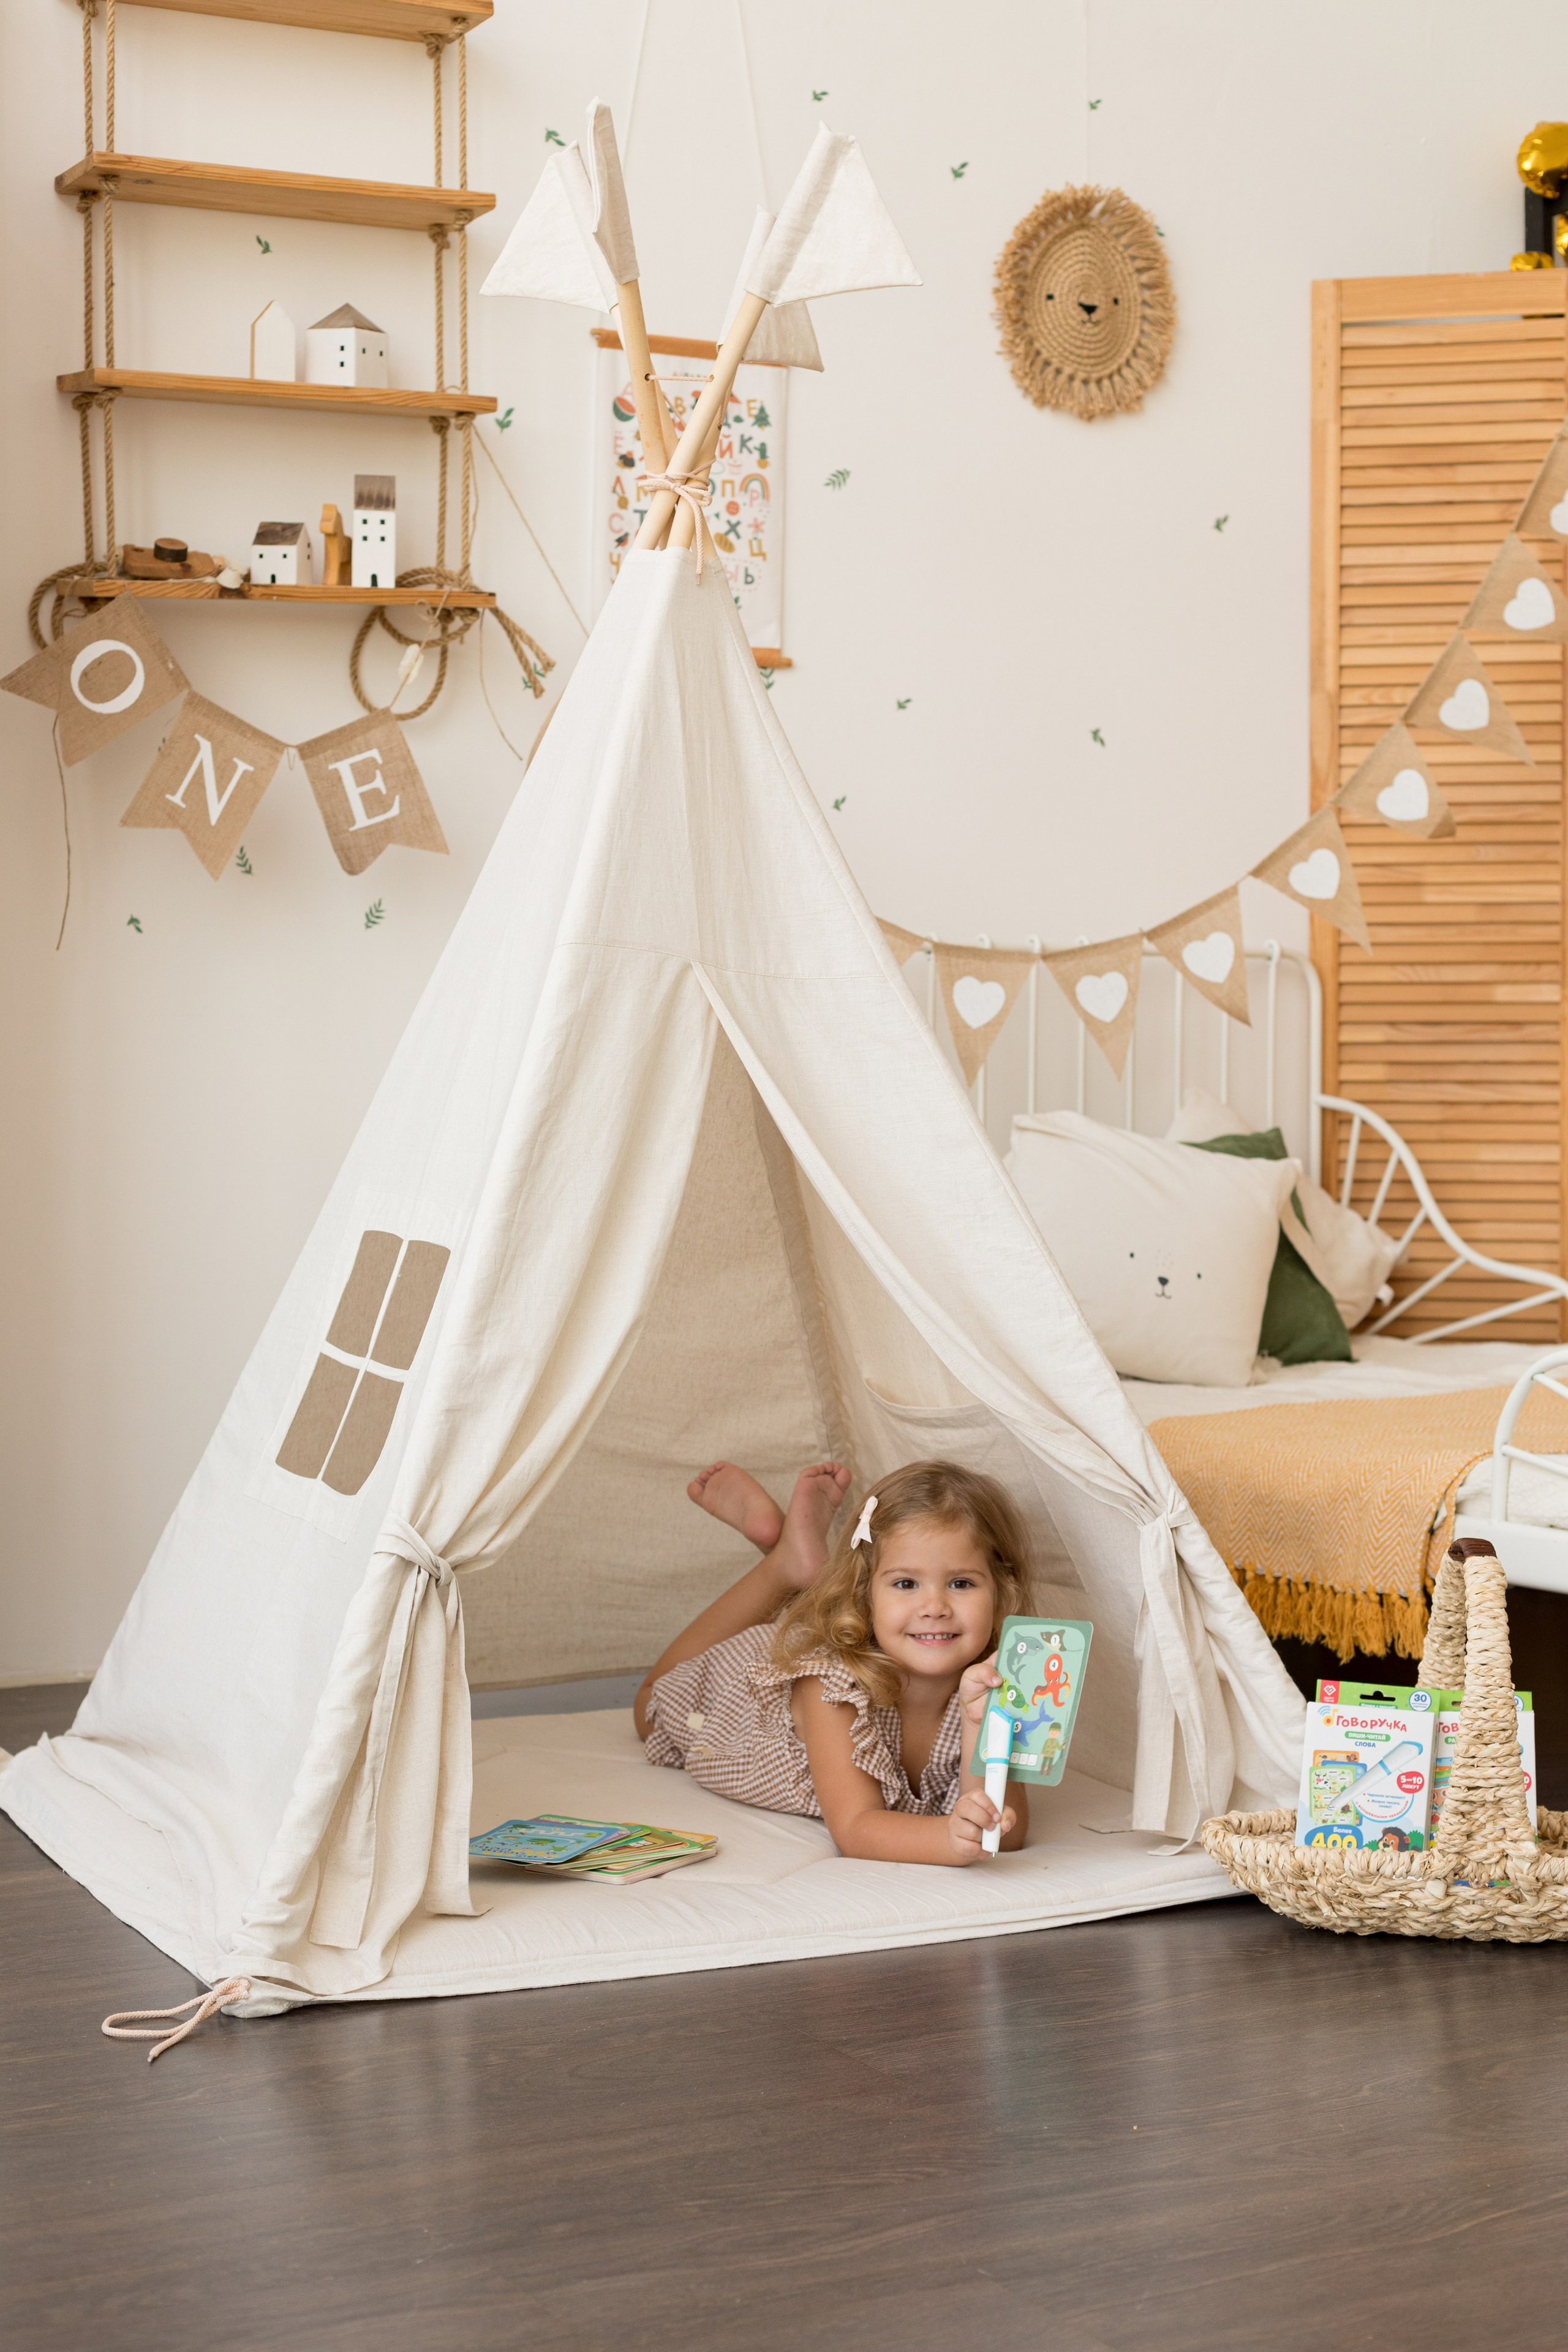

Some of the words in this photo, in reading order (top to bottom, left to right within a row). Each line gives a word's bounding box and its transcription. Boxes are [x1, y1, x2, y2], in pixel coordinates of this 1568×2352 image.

[746, 399, 758, 418] Е
[718, 434, 733, 459] Й
[739, 434, 753, 454] К
[721, 480, 735, 498] П
[748, 539, 767, 561] Ц
[1348, 1732, 1386, 1741] ПИШИ-ЧИТАЙ
[1311, 1832, 1357, 1850] 400
